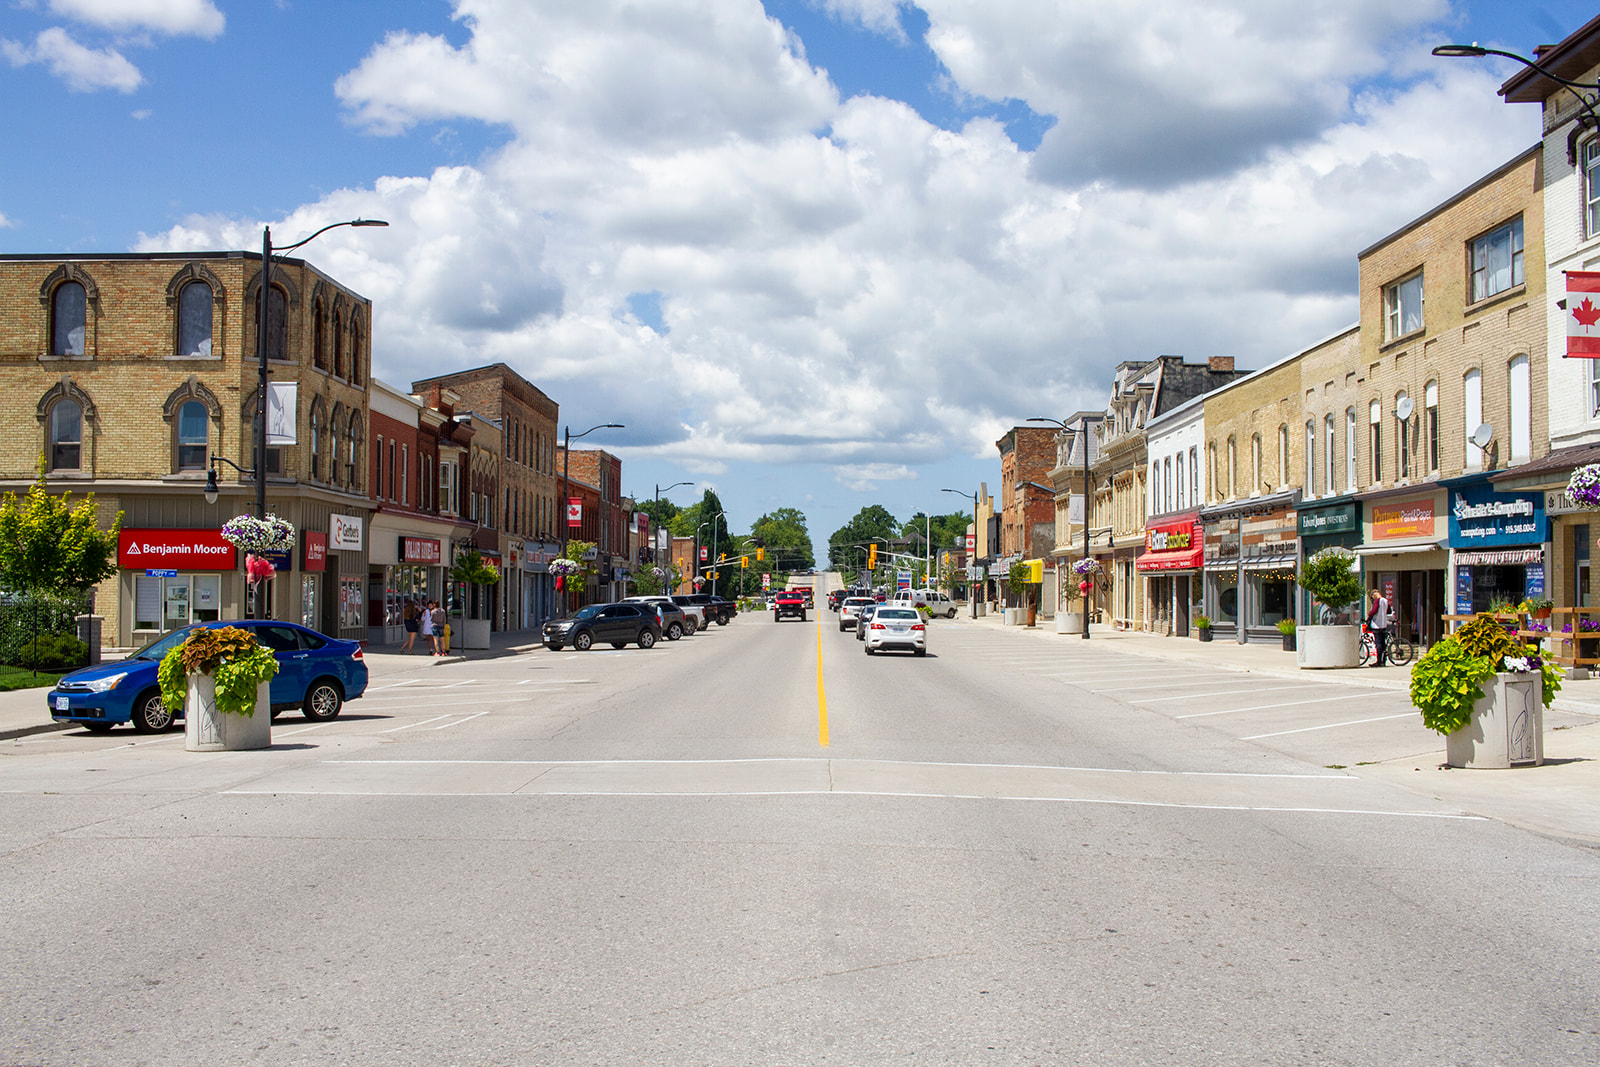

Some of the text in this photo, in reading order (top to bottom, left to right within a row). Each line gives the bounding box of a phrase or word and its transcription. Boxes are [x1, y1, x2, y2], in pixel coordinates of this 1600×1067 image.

[1557, 493, 1573, 509] The
[1374, 509, 1401, 525] Partners
[1151, 529, 1167, 550] Home
[143, 543, 228, 556] Benjamin Moore
